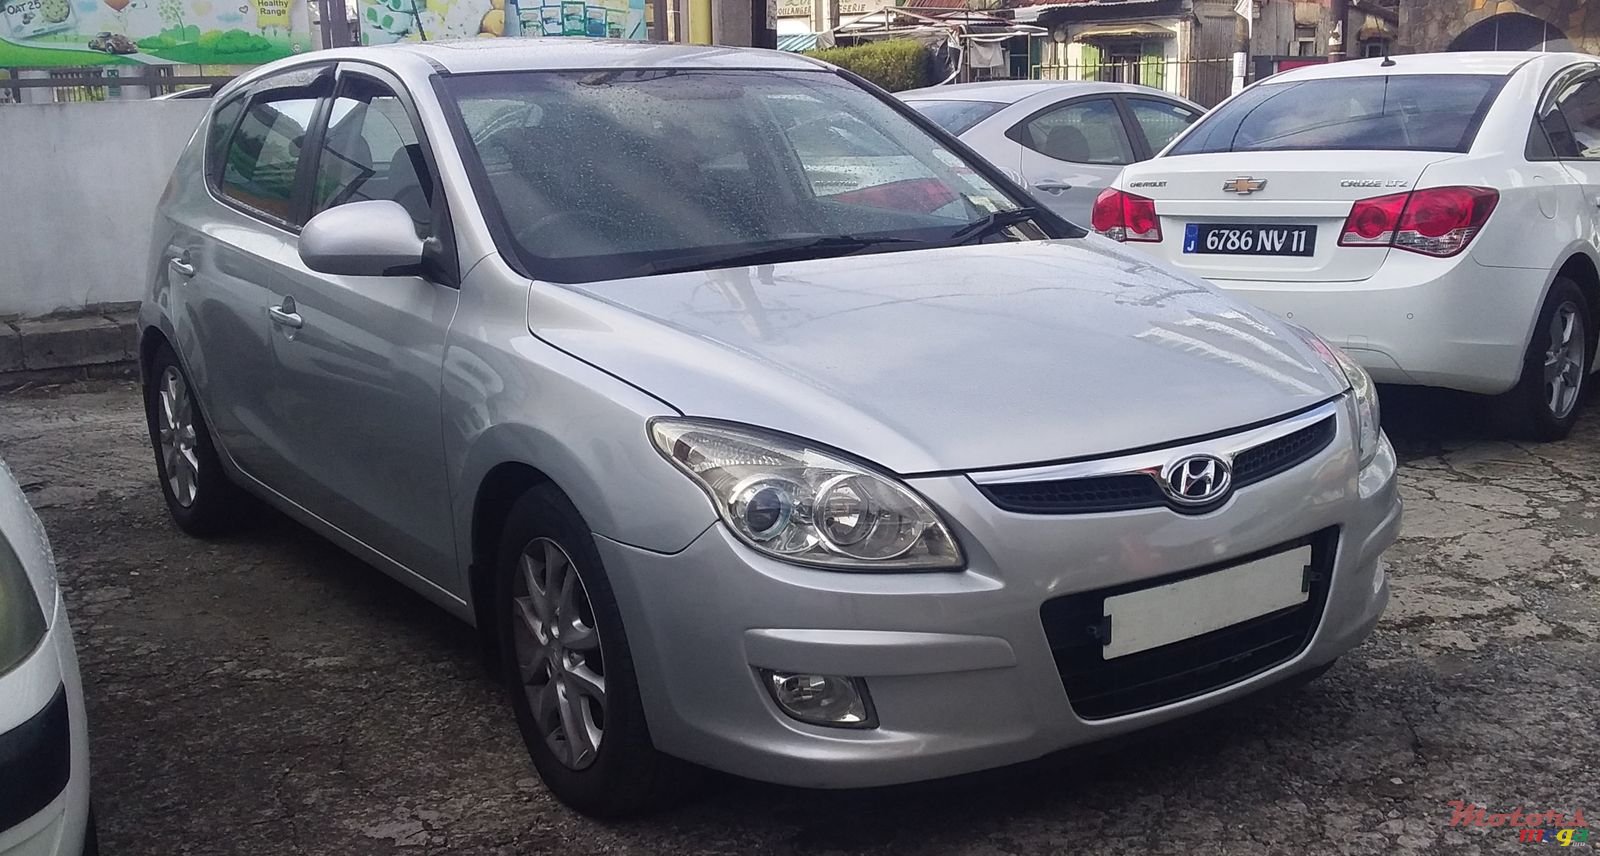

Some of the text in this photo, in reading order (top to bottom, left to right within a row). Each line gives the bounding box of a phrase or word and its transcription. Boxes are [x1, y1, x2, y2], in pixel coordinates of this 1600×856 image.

[7, 1, 42, 15] OAT 25
[257, 0, 289, 8] Healthy
[260, 8, 286, 16] Range
[1340, 179, 1408, 187] CRUZE LTZ
[1186, 229, 1306, 252] J 6786 NV 11
